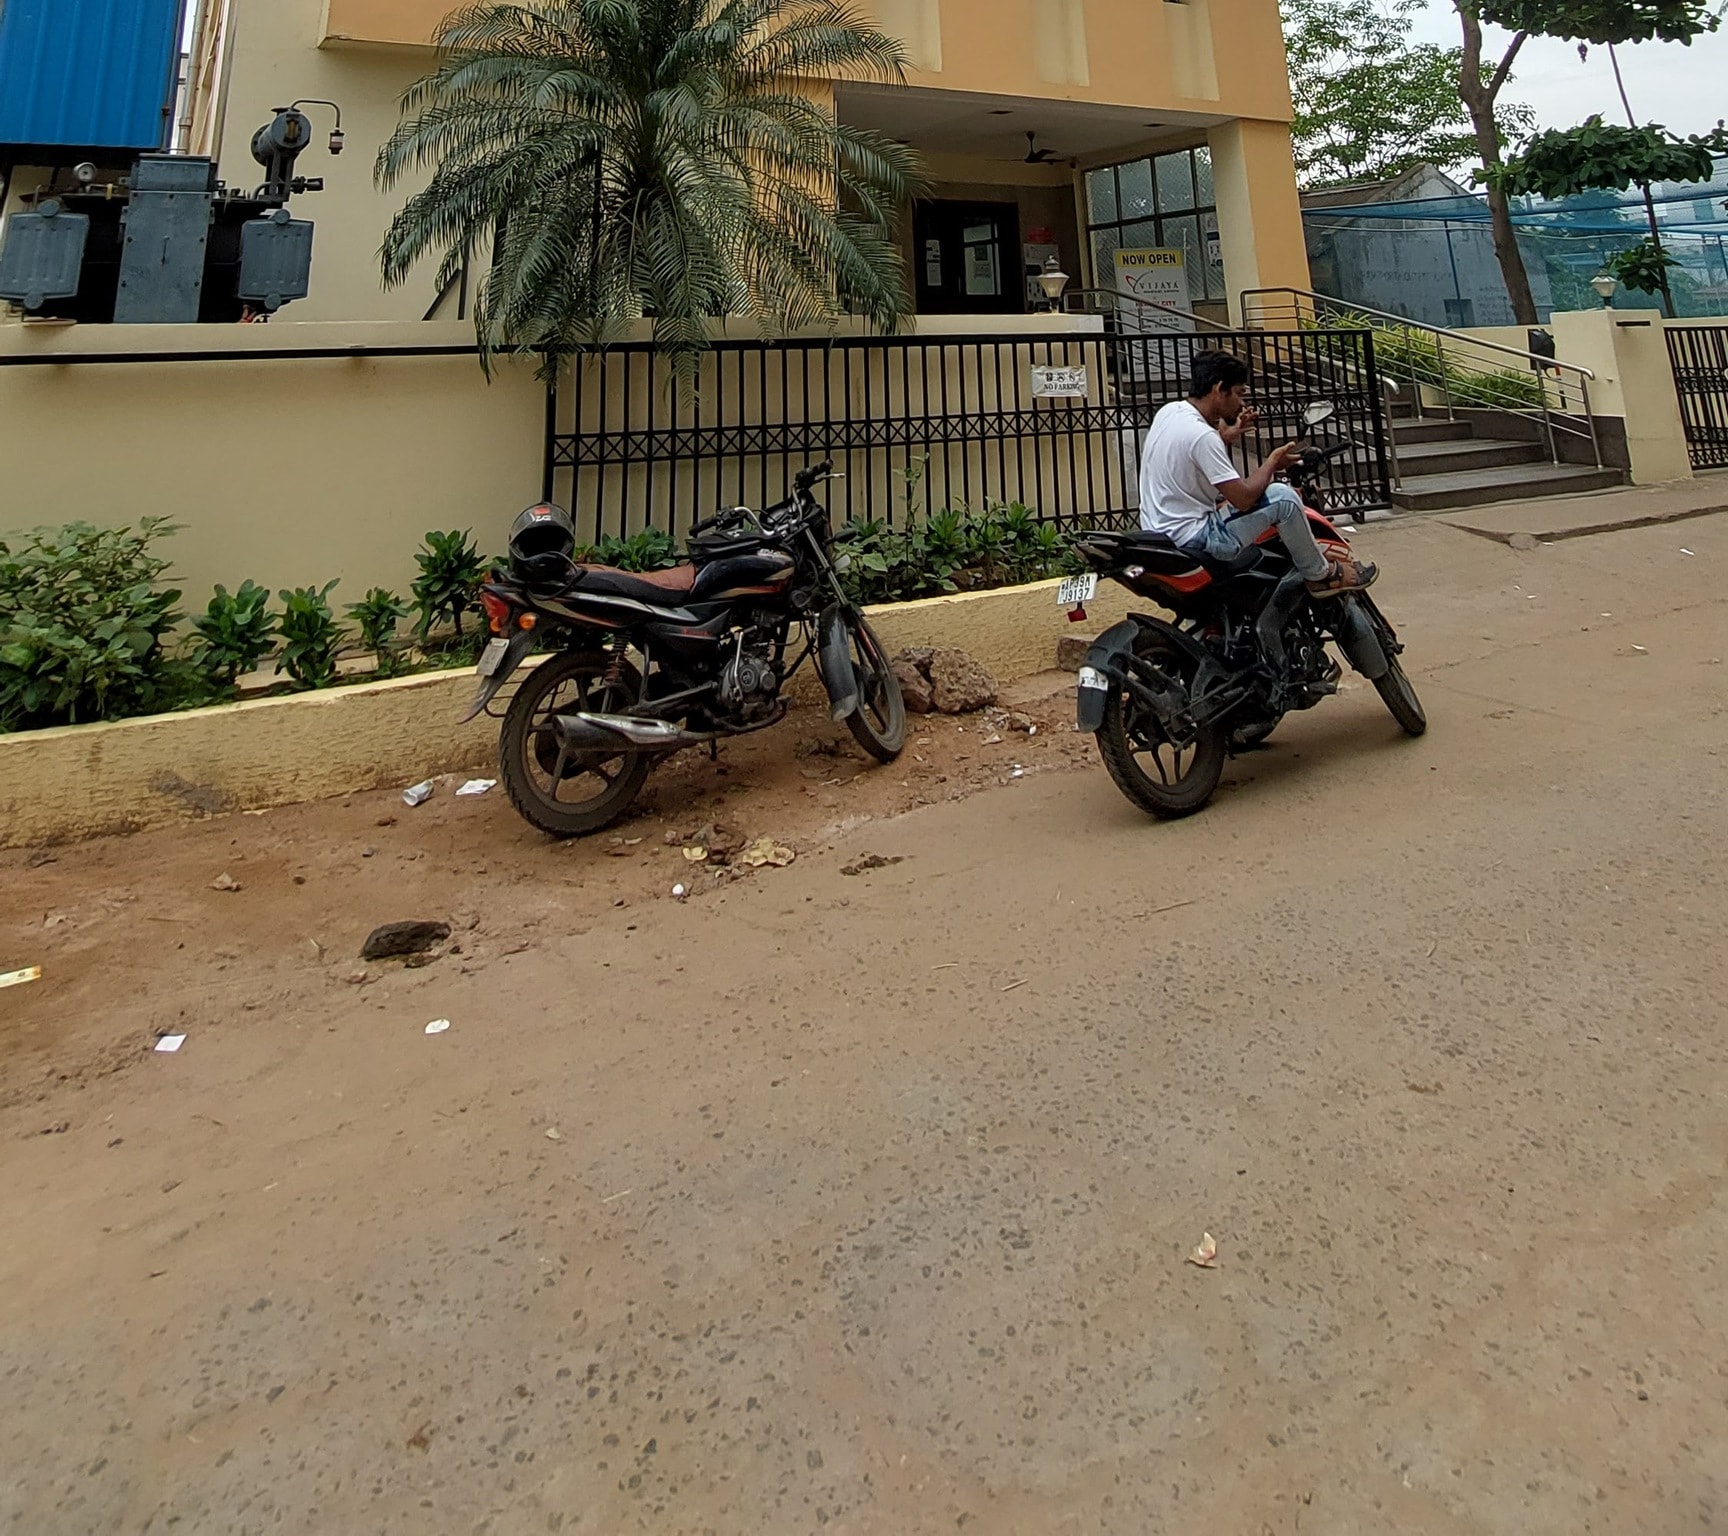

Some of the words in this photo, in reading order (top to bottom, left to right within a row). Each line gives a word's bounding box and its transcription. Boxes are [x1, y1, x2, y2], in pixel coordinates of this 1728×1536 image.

[1122, 254, 1146, 265] NOW
[1148, 253, 1177, 265] OPEN
[1139, 281, 1179, 290] VIJAYA
